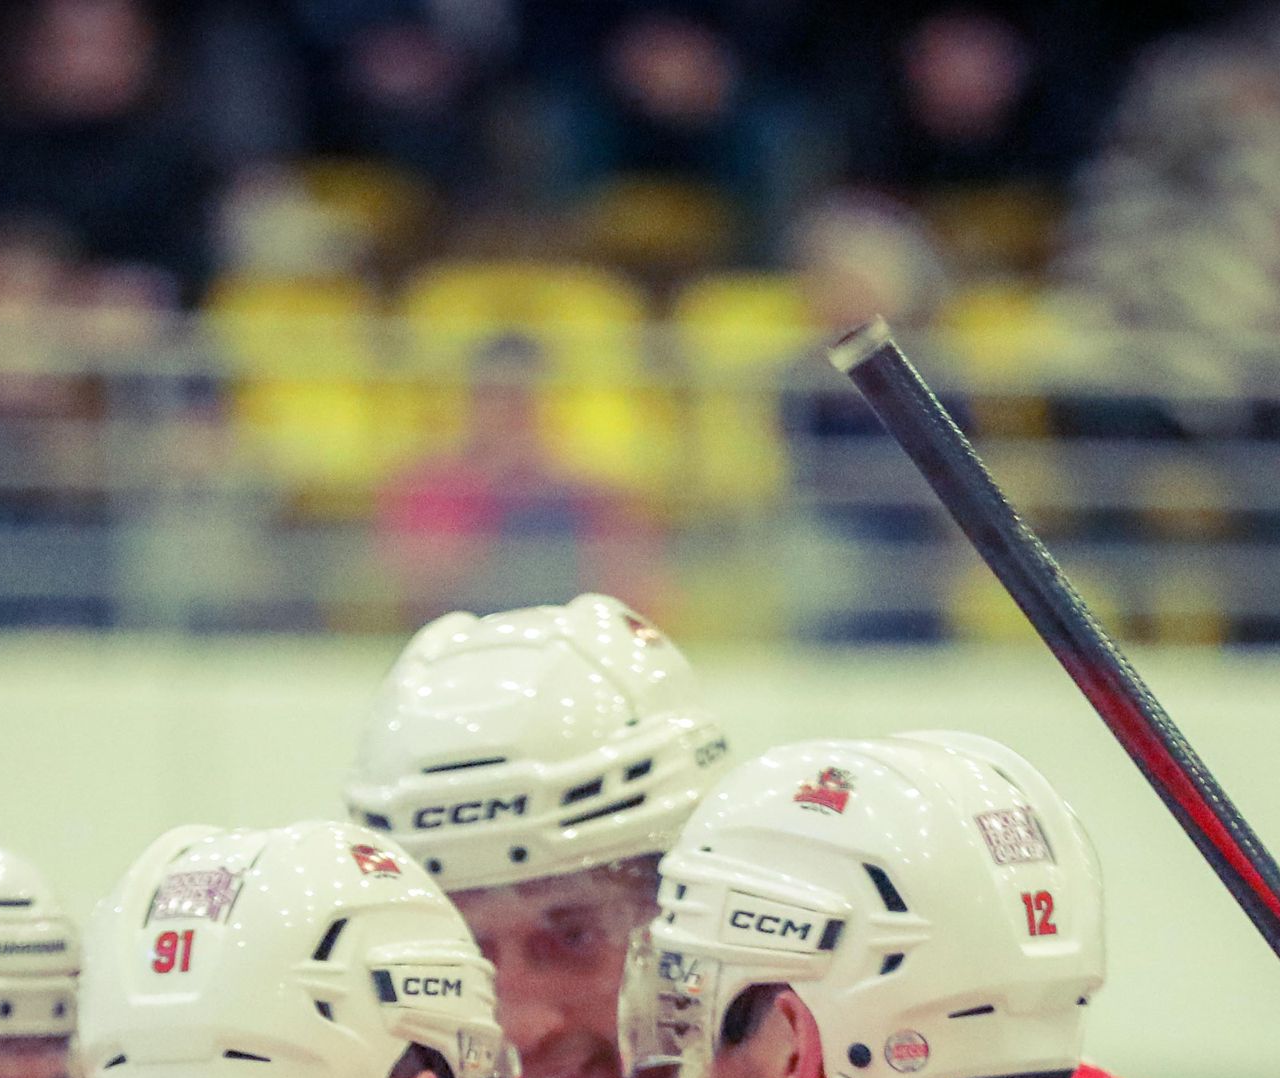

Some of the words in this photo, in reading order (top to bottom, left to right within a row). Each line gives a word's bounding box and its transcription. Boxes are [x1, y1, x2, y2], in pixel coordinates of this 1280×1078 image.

[413, 795, 528, 830] CCM
[730, 909, 812, 940] CCM
[1021, 890, 1057, 936] 12
[153, 929, 195, 973] 91
[403, 977, 462, 997] CCM
